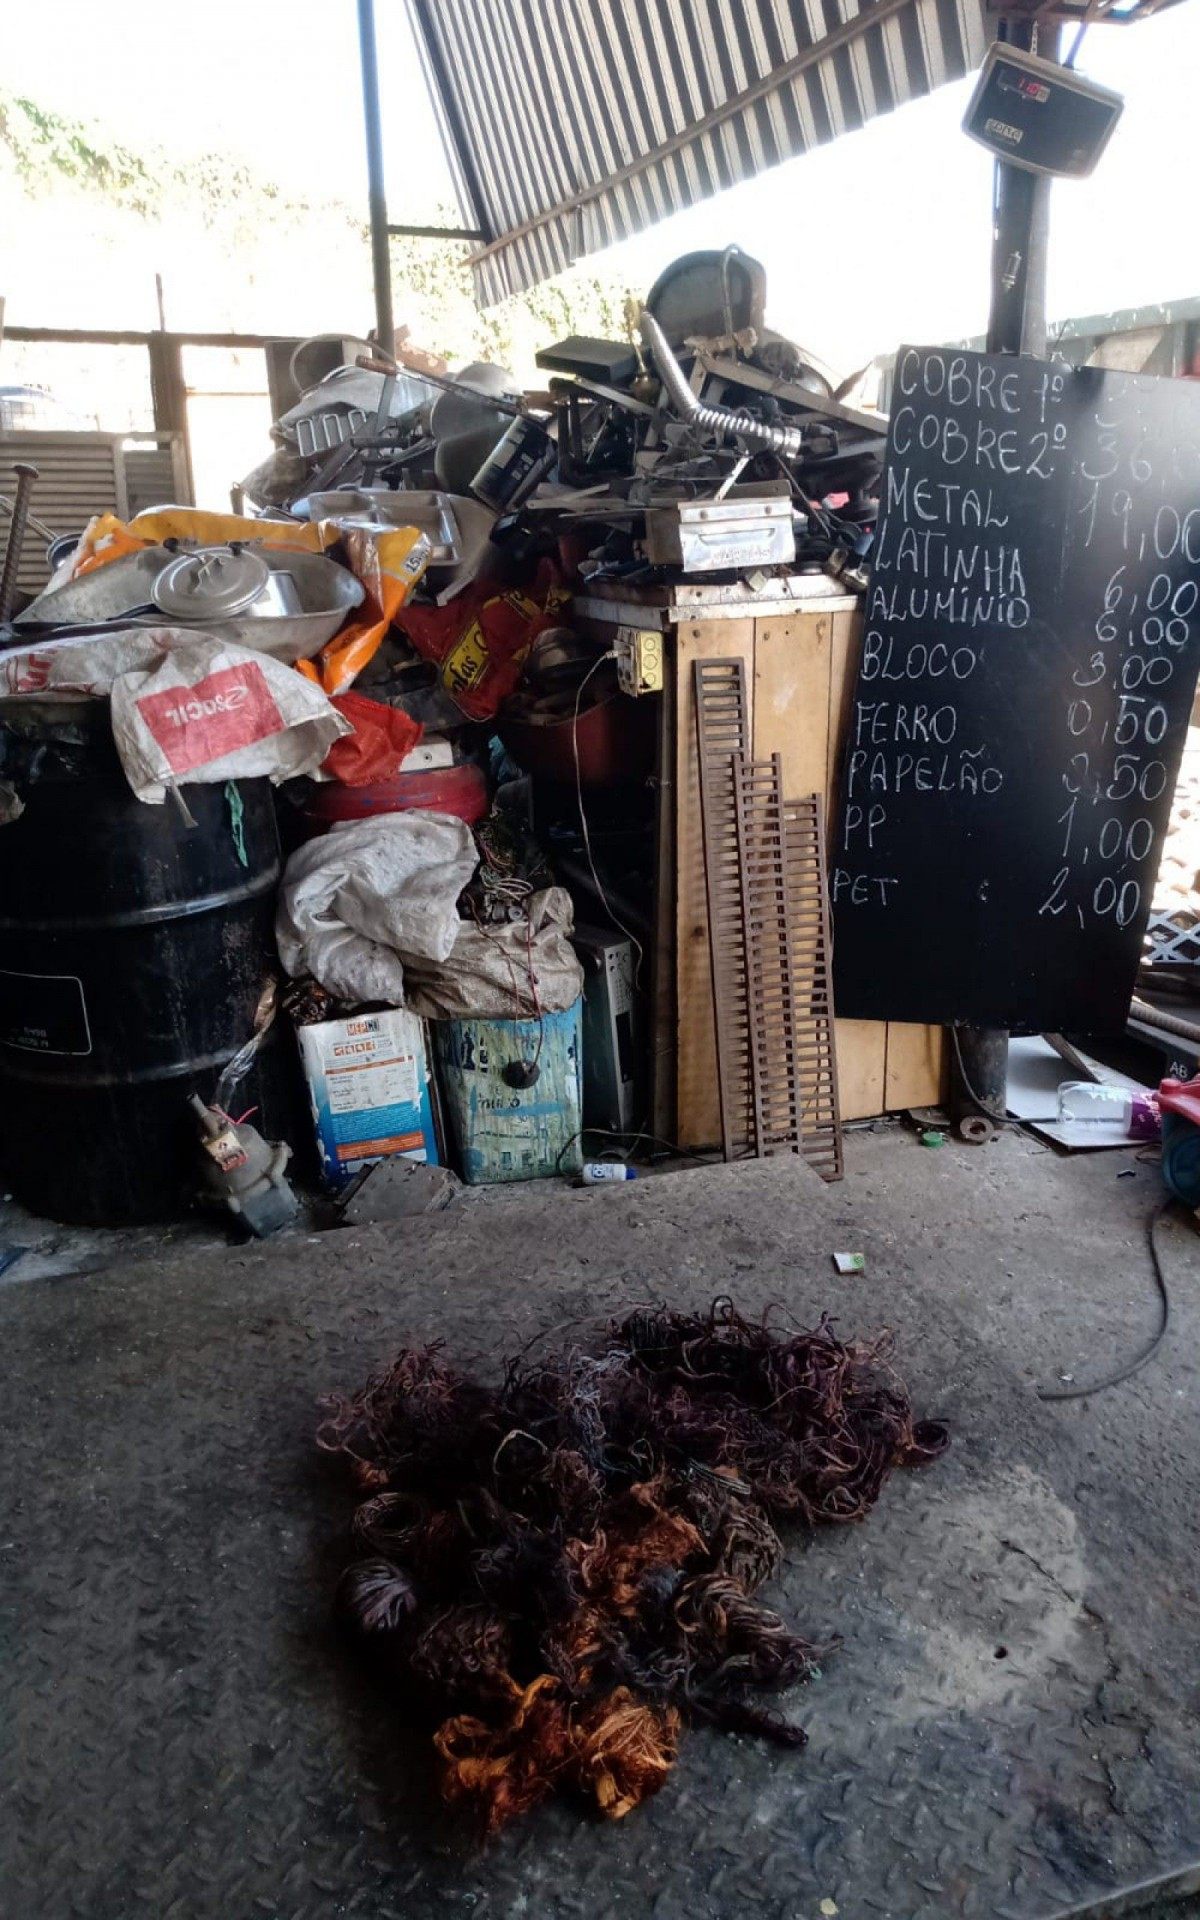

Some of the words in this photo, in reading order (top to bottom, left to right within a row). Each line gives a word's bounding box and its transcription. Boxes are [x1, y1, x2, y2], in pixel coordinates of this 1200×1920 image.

[900, 349, 1021, 414] COBRE
[893, 406, 1021, 474] COBRE
[887, 466, 1009, 528] METAL
[875, 519, 1026, 598] LATINHA
[1104, 565, 1198, 617] 6,00
[861, 631, 977, 680] BLOCO
[1095, 609, 1189, 646] 6,00
[855, 701, 957, 746] FERRO
[1067, 695, 1168, 744] 0,50
[849, 744, 1003, 798] PAPELÃO
[844, 803, 886, 850] PP
[1058, 797, 1154, 864] 1,00
[833, 868, 899, 906] PET
[1039, 866, 1141, 930] 2,00
